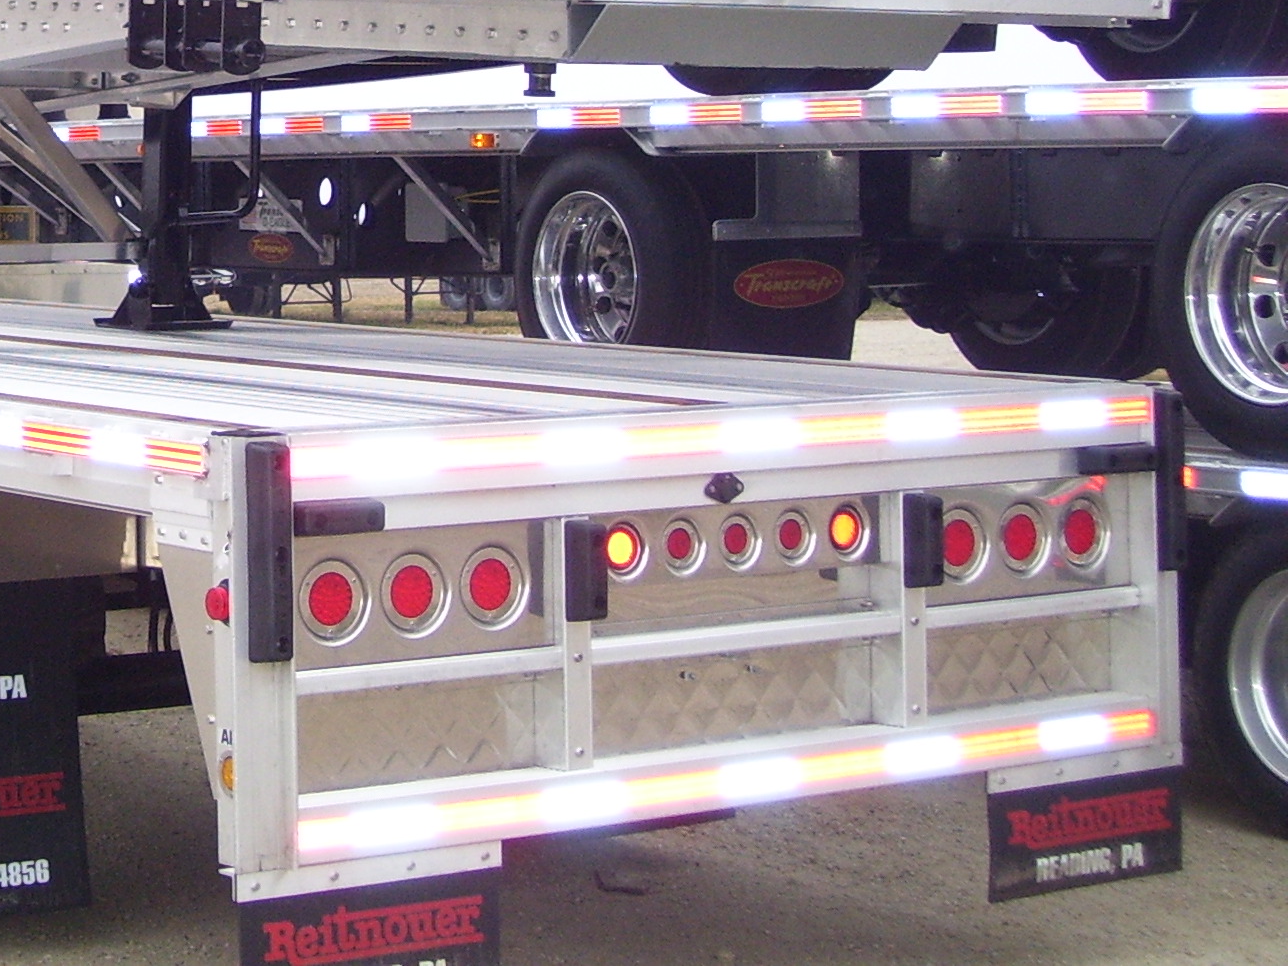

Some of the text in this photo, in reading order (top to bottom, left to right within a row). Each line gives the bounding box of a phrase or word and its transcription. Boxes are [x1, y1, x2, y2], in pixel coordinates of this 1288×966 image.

[0, 674, 28, 700] PA
[1036, 842, 1144, 883] READING, PA
[263, 894, 485, 966] Reitnouer
